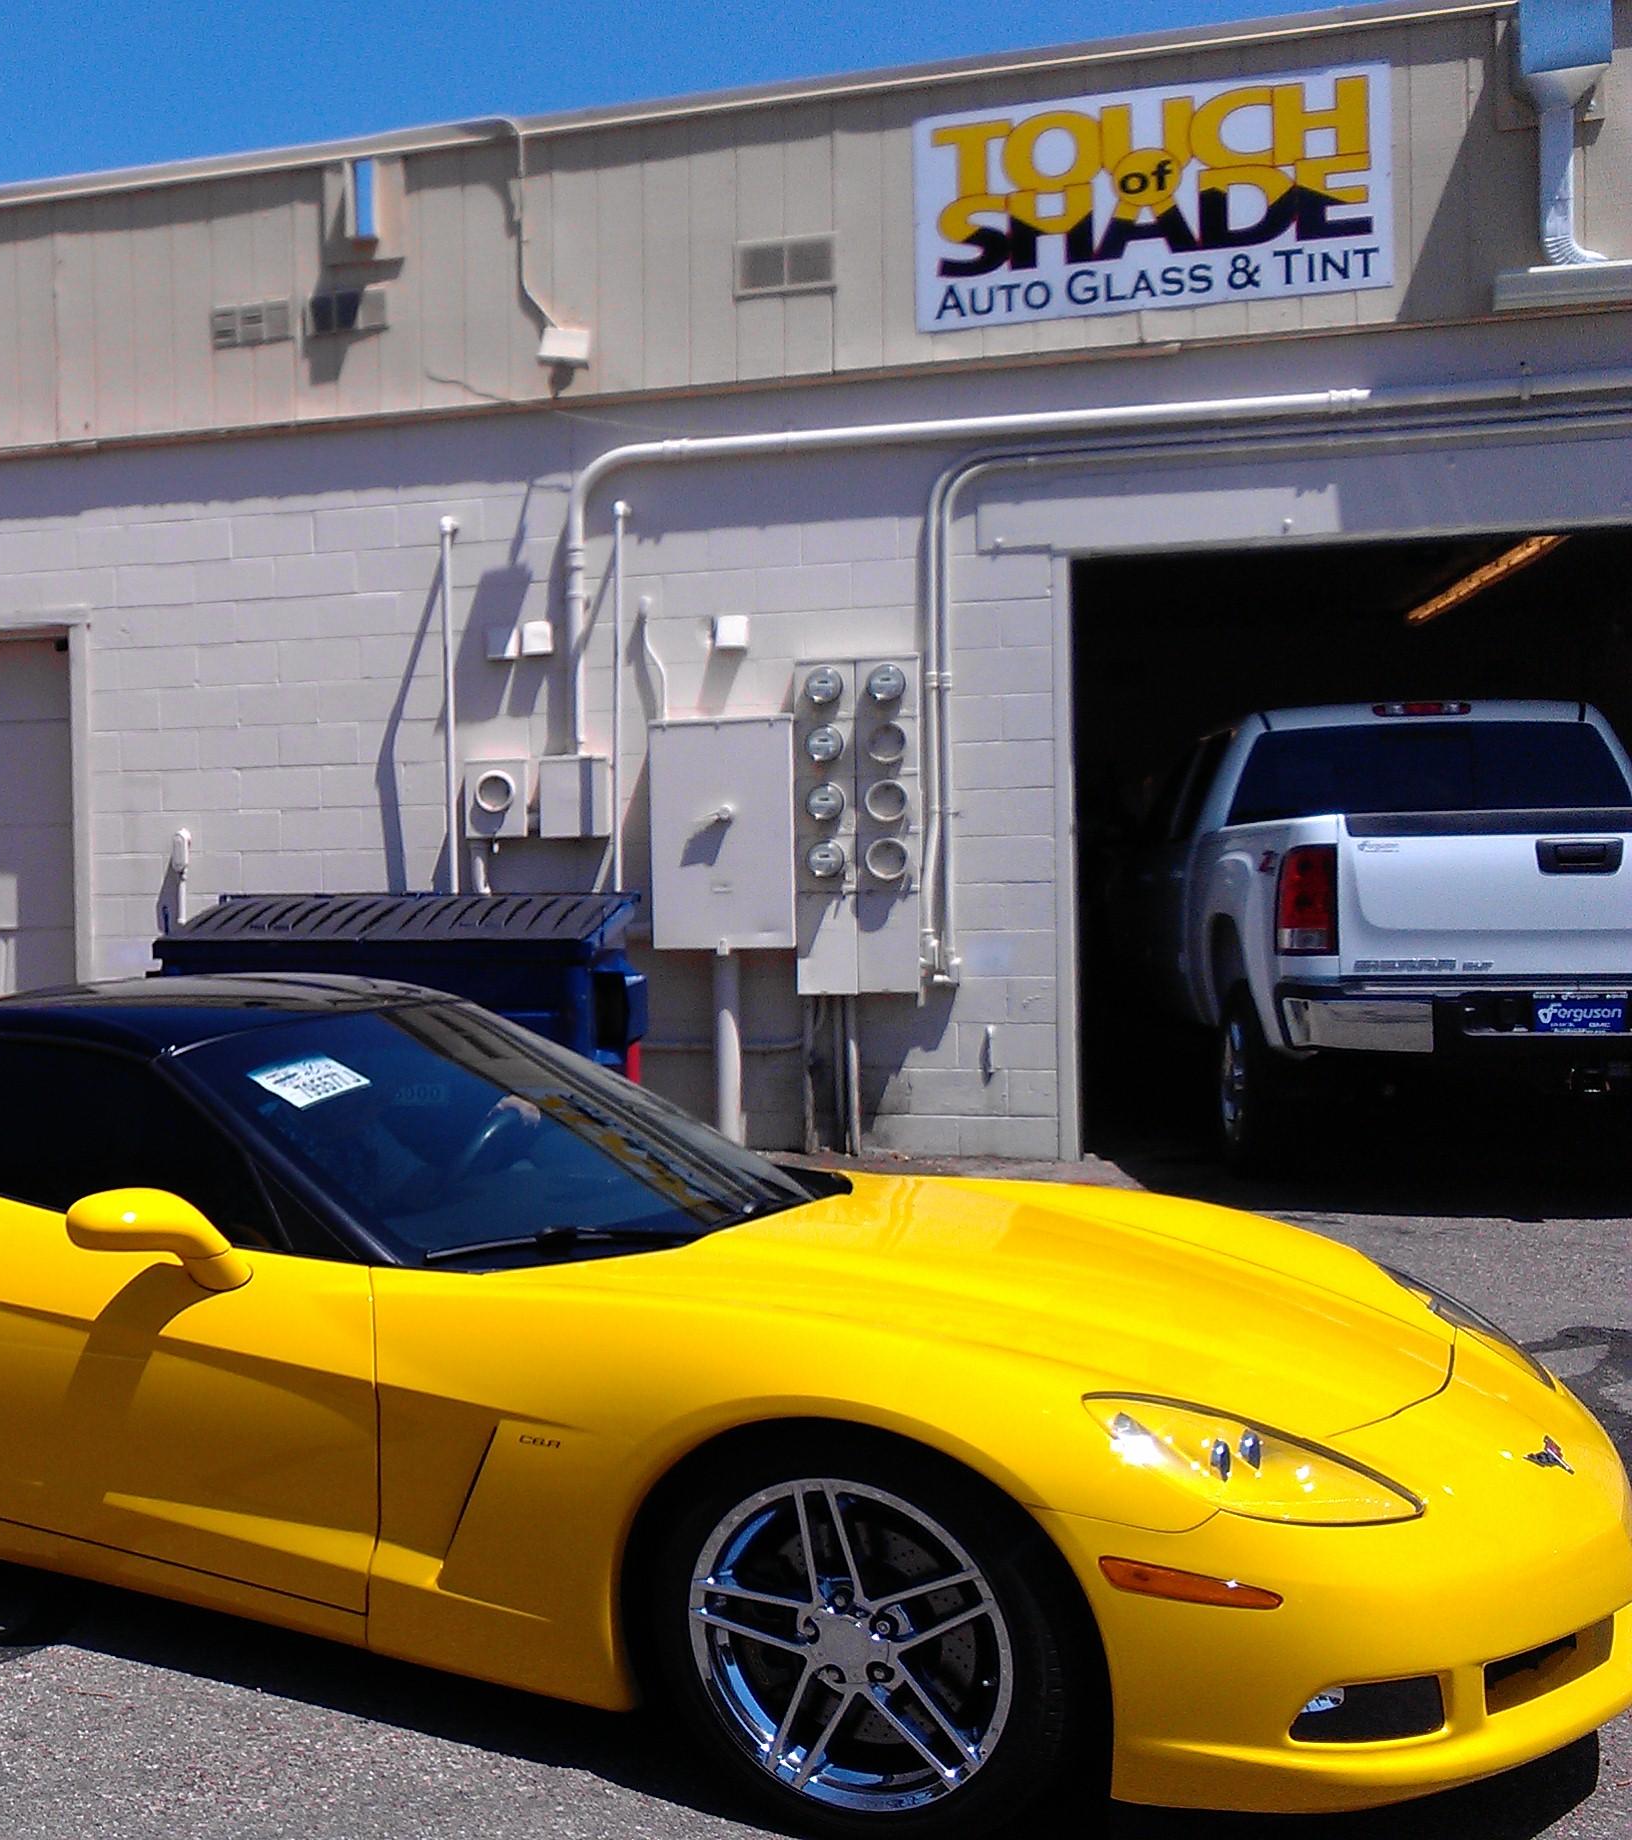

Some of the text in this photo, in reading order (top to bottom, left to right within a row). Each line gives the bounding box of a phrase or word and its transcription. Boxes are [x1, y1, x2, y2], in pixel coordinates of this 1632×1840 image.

[931, 75, 1369, 196] TOUCH
[1119, 159, 1174, 195] of
[937, 152, 1374, 278] SHADE
[1227, 253, 1261, 290] &
[1537, 1002, 1623, 1024] Ferguson
